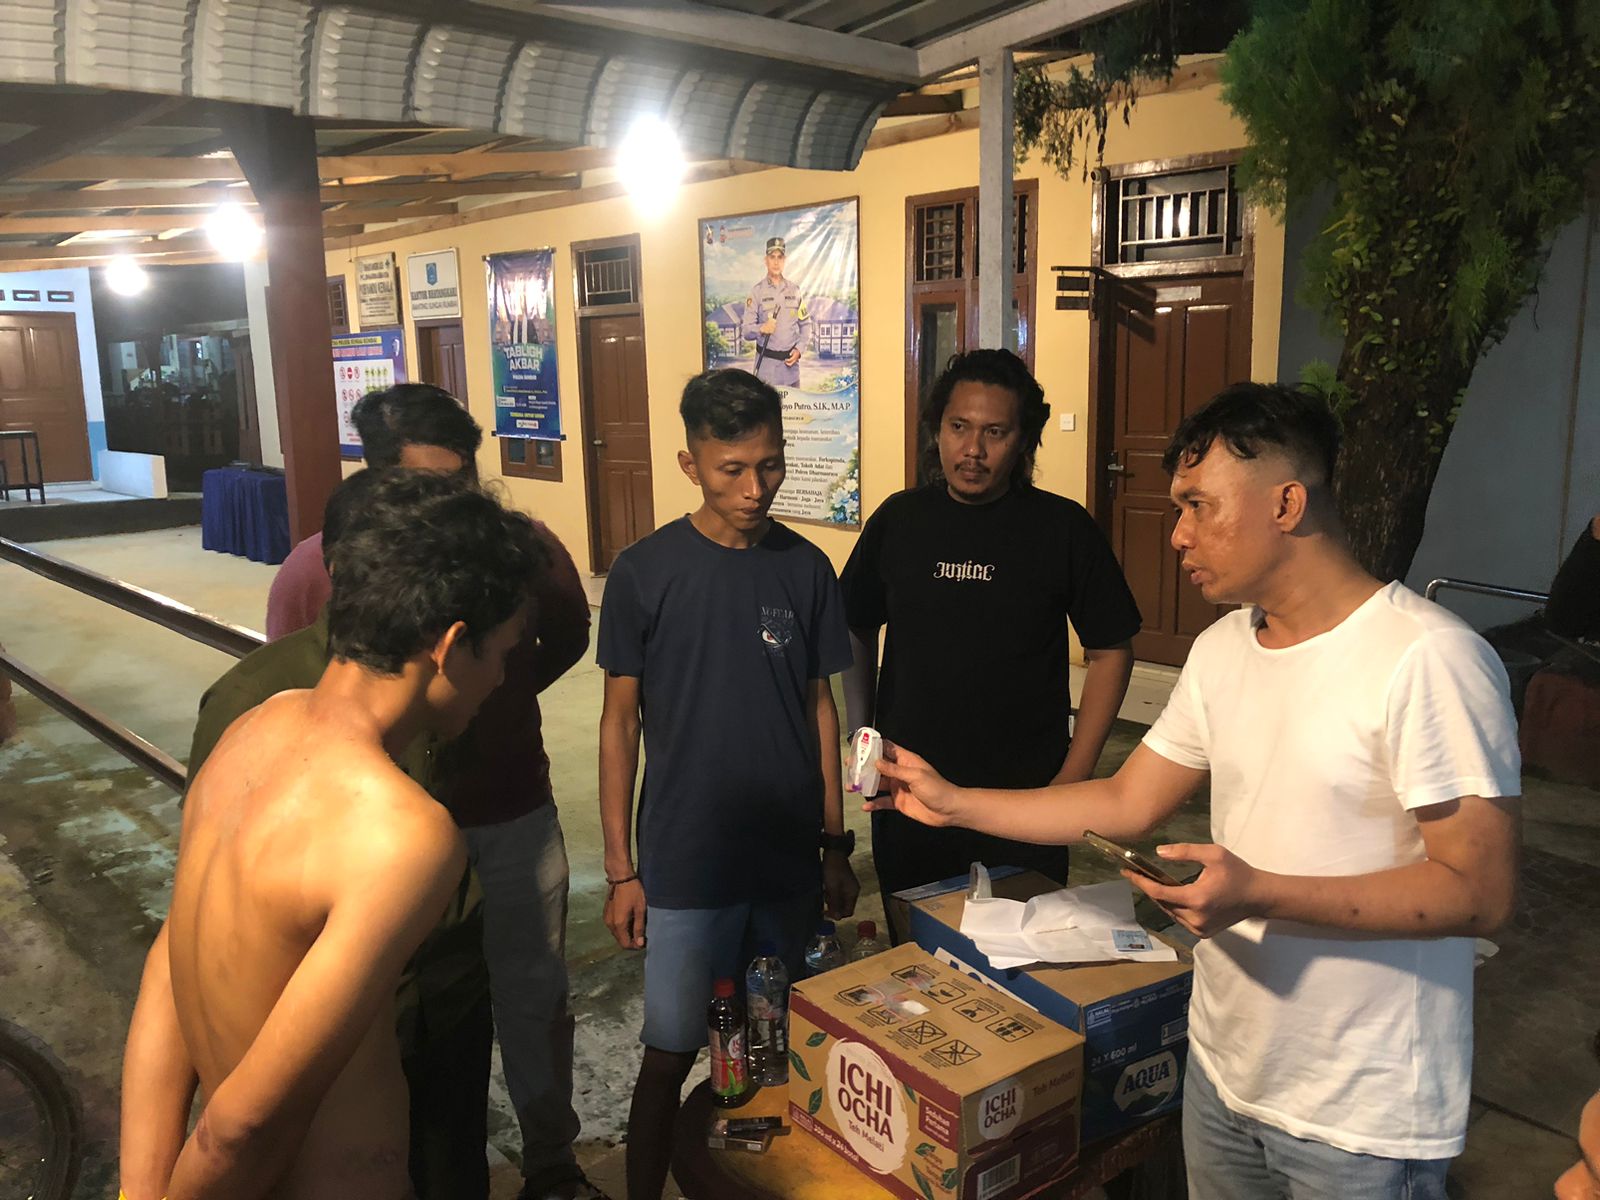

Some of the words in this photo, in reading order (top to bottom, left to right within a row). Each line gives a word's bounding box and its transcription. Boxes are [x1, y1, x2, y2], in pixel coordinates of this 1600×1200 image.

[504, 346, 543, 360] TABLIGH
[510, 358, 540, 372] AKBAR
[1110, 1047, 1127, 1060] 600
[840, 1054, 892, 1117] ICHI
[1122, 1061, 1170, 1095] AQUA
[838, 1087, 894, 1144] OCHA
[984, 1087, 1016, 1116] ICHI
[984, 1106, 1016, 1128] OCHA
[848, 1120, 861, 1136] Teh
[862, 1130, 885, 1152] Melati
